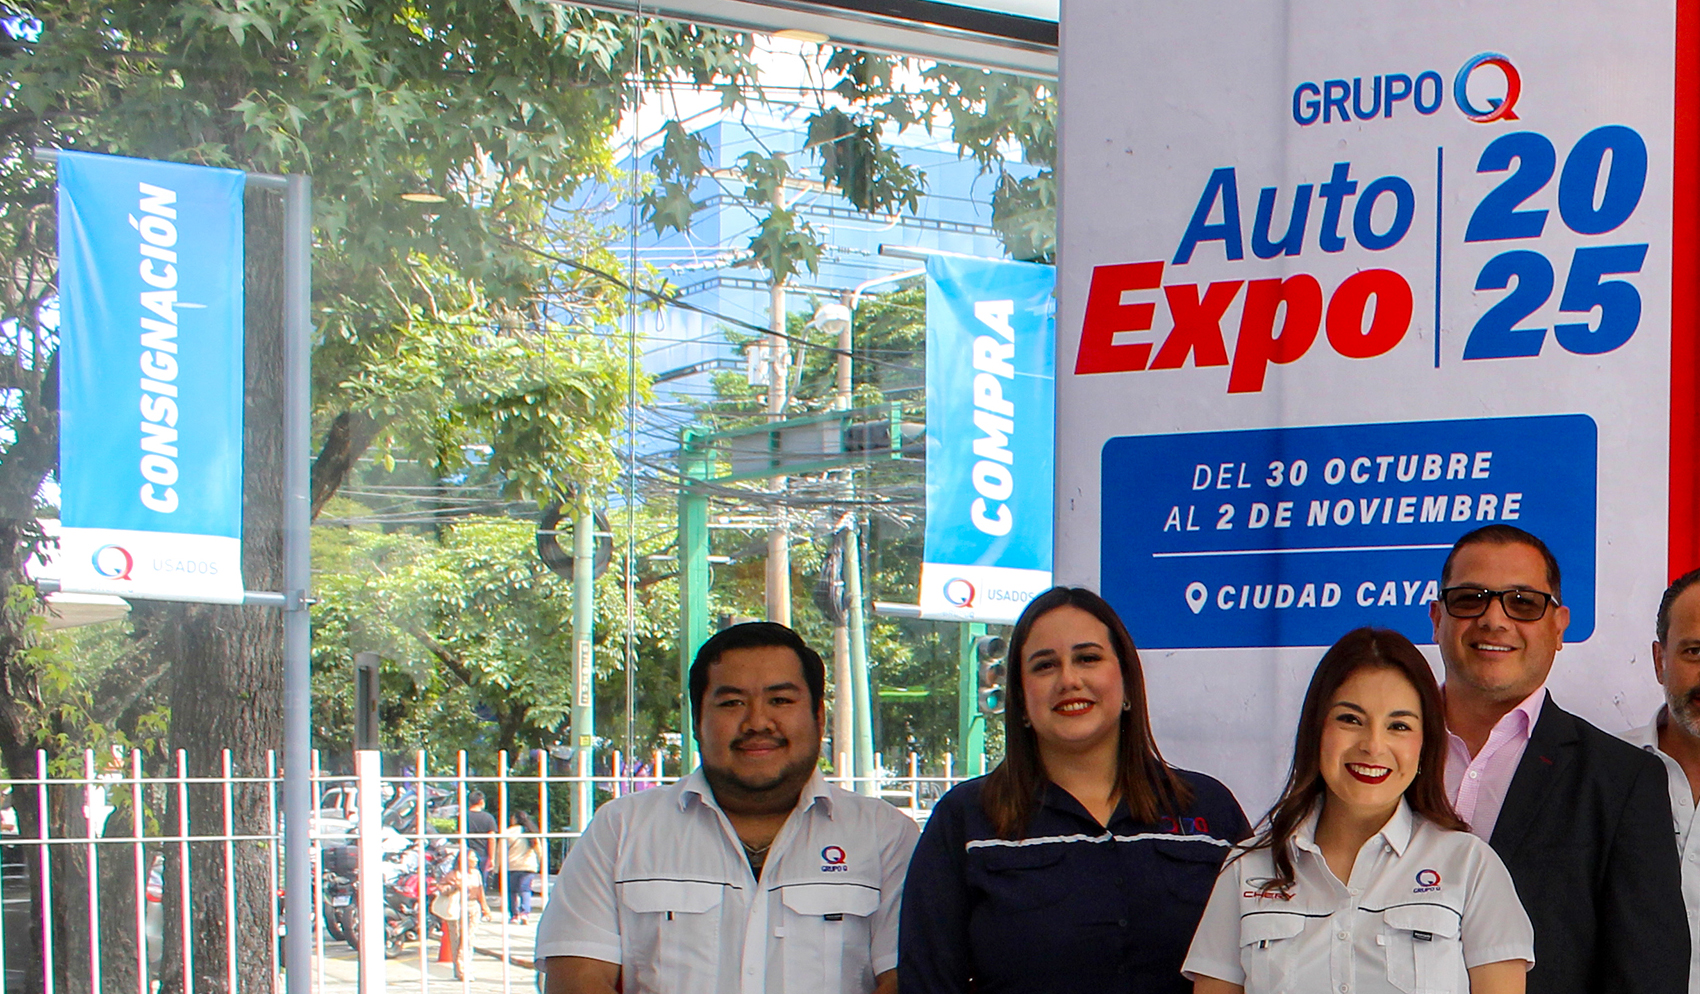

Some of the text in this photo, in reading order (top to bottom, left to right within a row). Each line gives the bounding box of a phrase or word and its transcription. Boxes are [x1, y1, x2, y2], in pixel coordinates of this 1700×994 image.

[1292, 52, 1521, 126] GRUPO Q
[1464, 125, 1648, 243] 20
[1171, 162, 1415, 266] Auto
[1074, 261, 1414, 393] Expo
[1462, 243, 1649, 360] 25
[128, 183, 179, 513] CONSIGNACIÓN
[970, 299, 1015, 537] COMPRA
[1192, 452, 1493, 490] DEL 30 OCTUBRE
[1163, 493, 1522, 531] AL 2 DE NOVIEMBRE
[153, 559, 218, 575] USADOS
[1217, 580, 1440, 609] CIUDAD CAYA
[988, 589, 1034, 603] USADOS
[821, 865, 842, 873] GRUPO
[1243, 891, 1296, 901] CHERY
